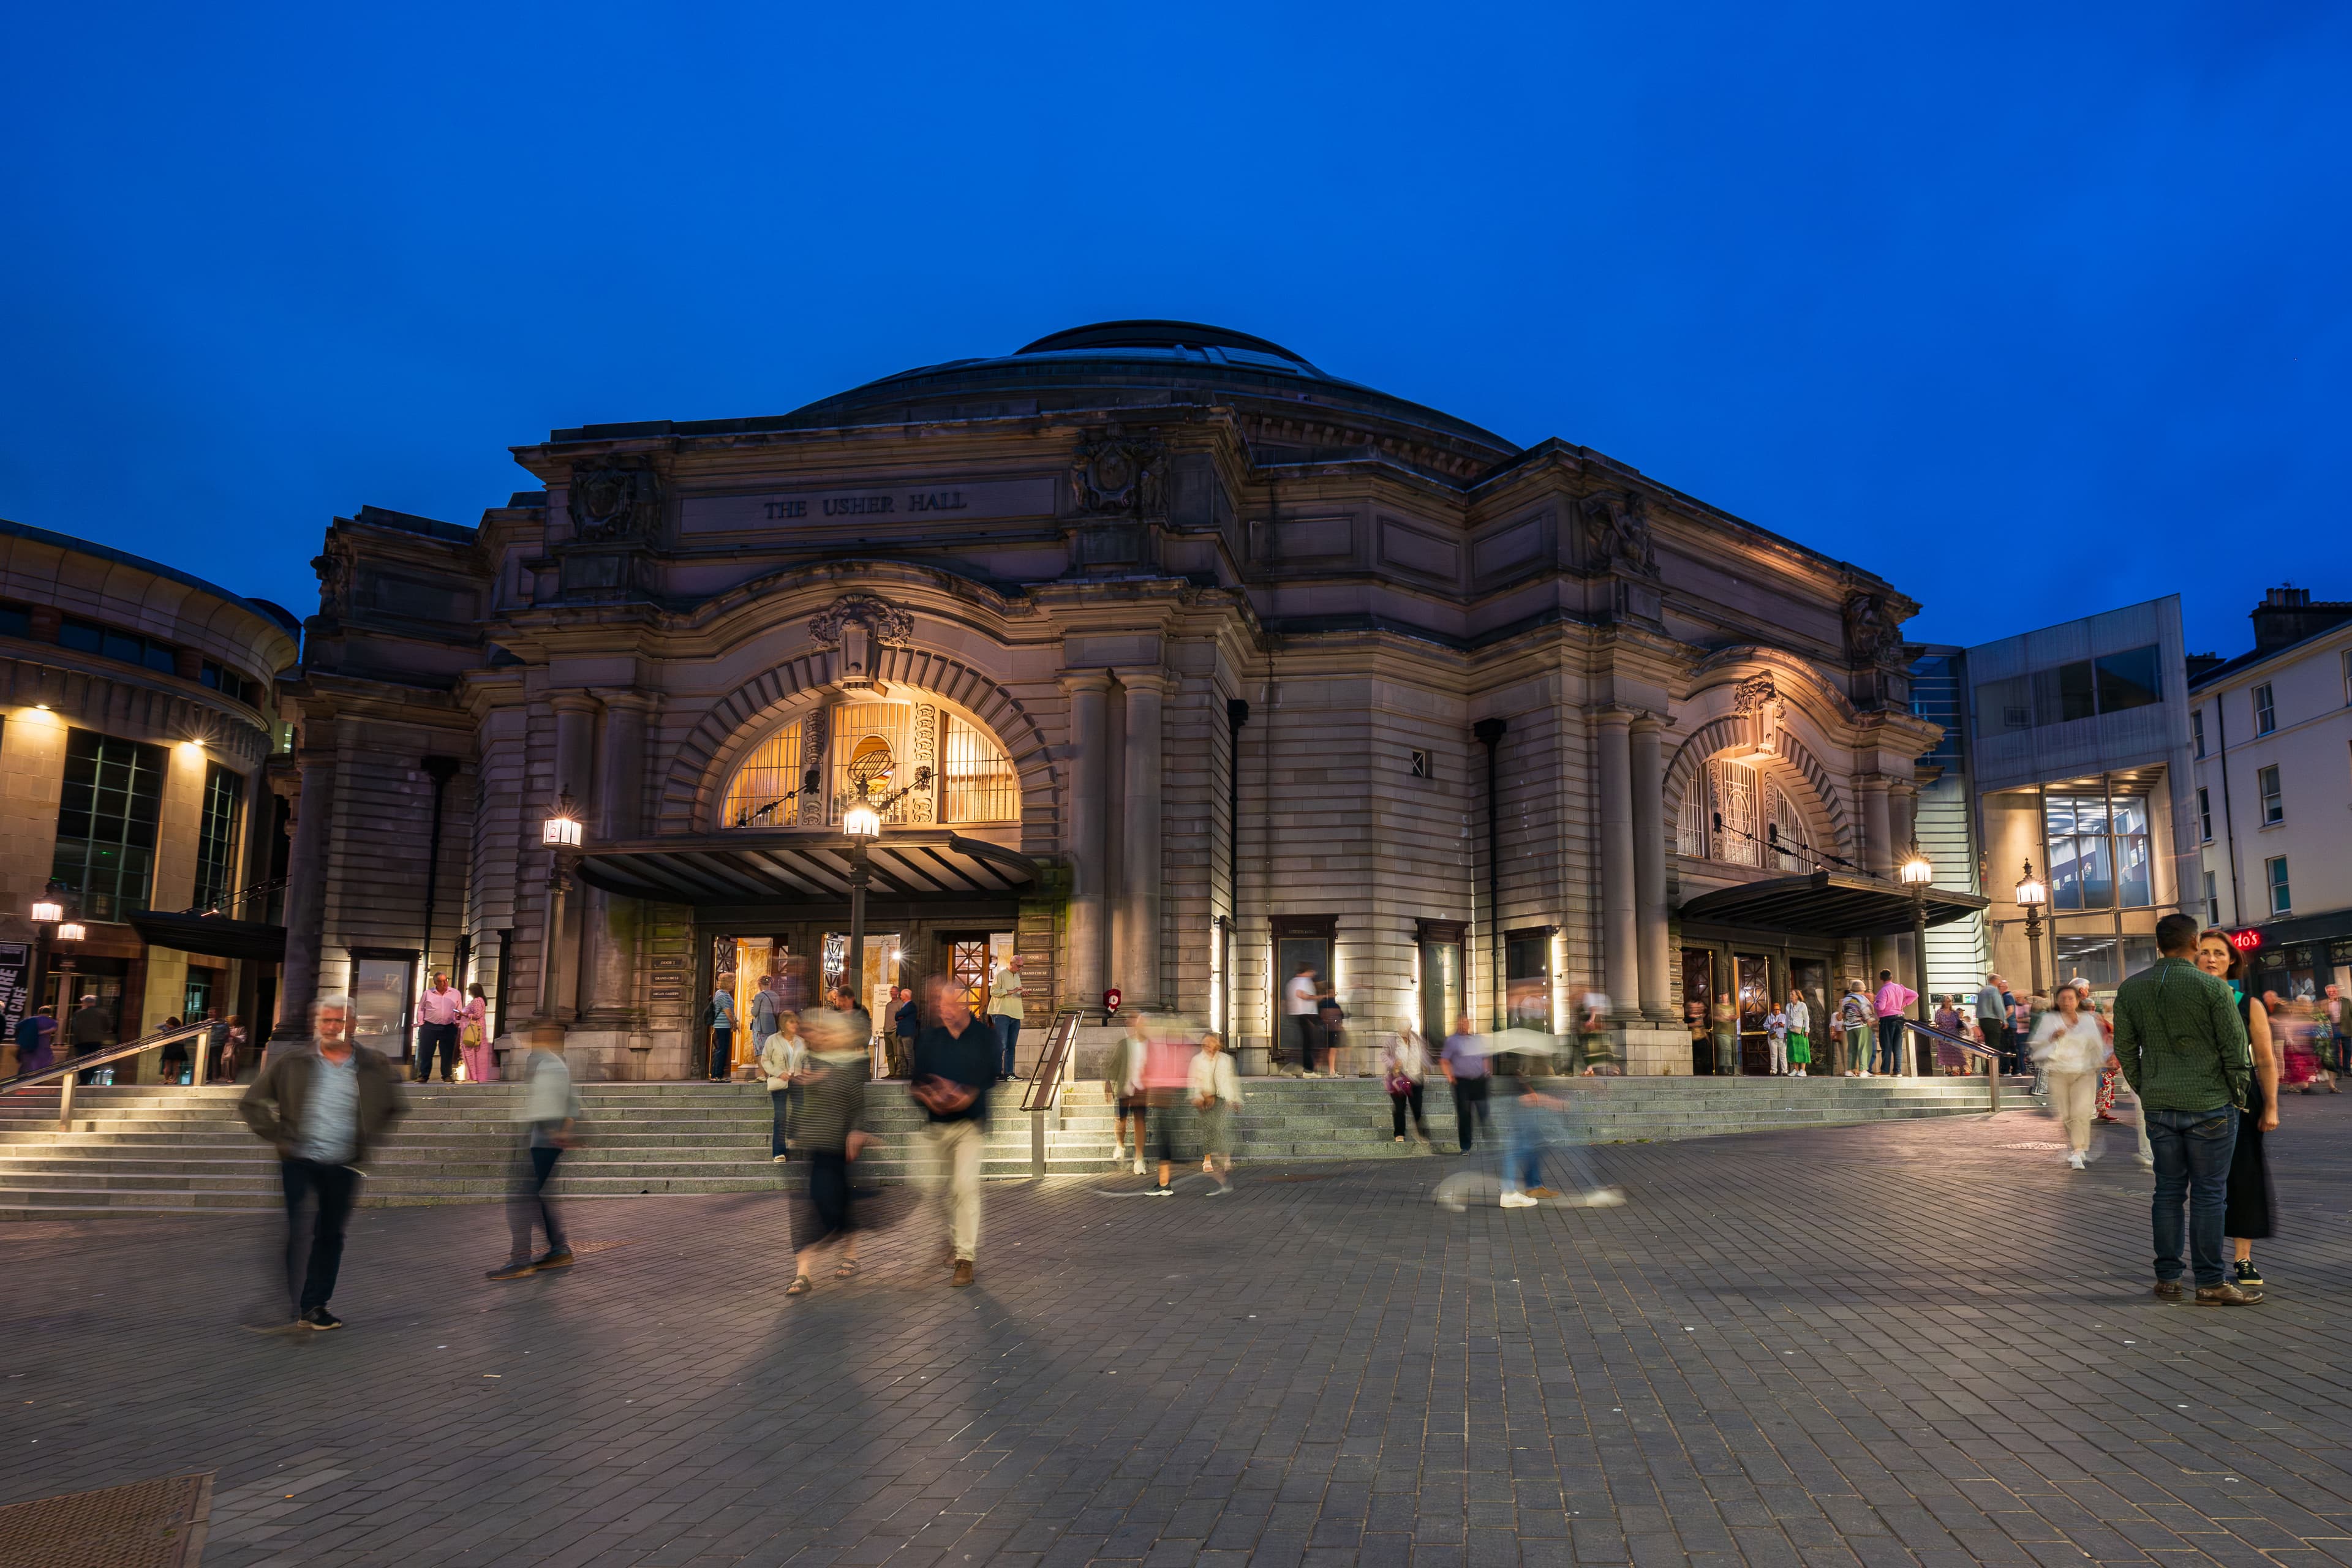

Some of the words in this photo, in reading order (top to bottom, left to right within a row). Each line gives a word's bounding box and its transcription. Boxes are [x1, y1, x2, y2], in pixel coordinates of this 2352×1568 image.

[764, 499, 807, 520] THE
[823, 496, 894, 516] USHER
[908, 491, 968, 512] HALL
[2234, 930, 2258, 947] do's
[4, 1014, 20, 1035] BAR
